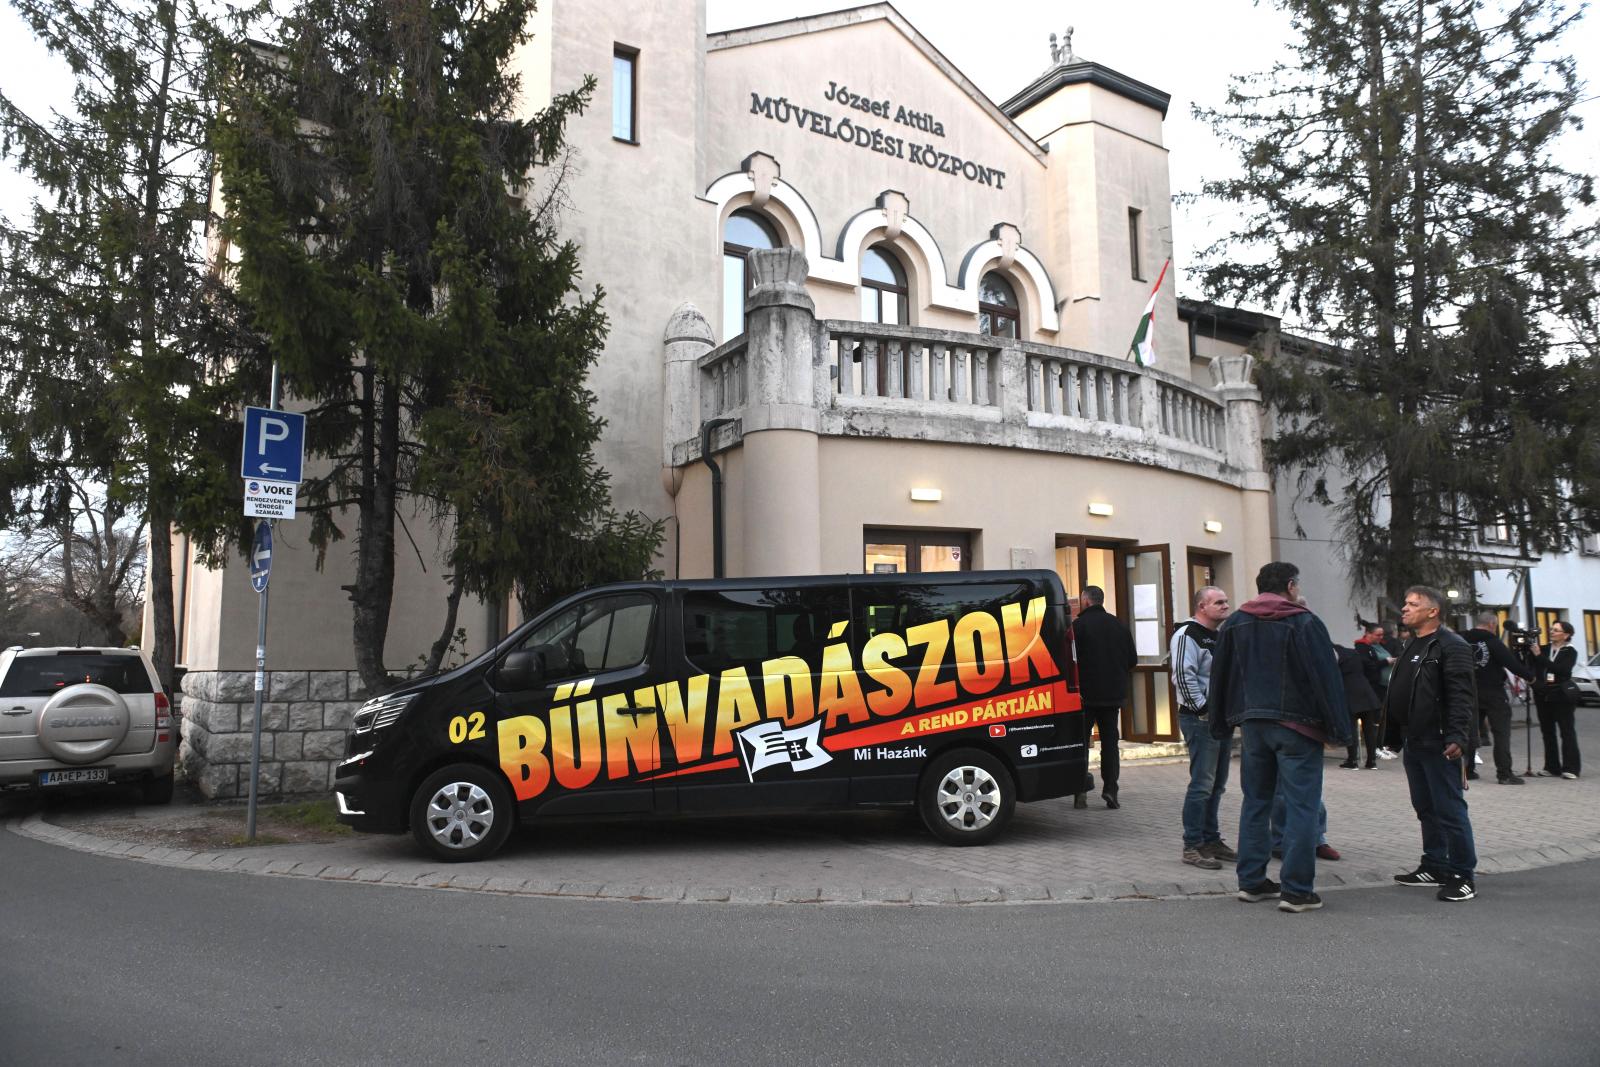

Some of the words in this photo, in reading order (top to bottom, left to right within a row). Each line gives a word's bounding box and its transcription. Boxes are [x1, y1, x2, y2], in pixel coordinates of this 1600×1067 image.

[824, 81, 890, 119] József
[893, 105, 945, 137] Attila
[750, 92, 904, 159] MŰVELŐDÉSI
[908, 142, 1006, 190] KÖZPONT
[258, 417, 289, 455] P
[263, 485, 293, 496] VOKE
[497, 596, 1060, 801] BŰNVADÁSZOK
[901, 722, 915, 735] A
[918, 710, 968, 732] REND
[972, 691, 1052, 721] PÁRTJÁN
[50, 716, 120, 728] SUZUKI
[449, 711, 486, 744] 02
[854, 748, 871, 761] Mi
[877, 745, 927, 760] Hazánk
